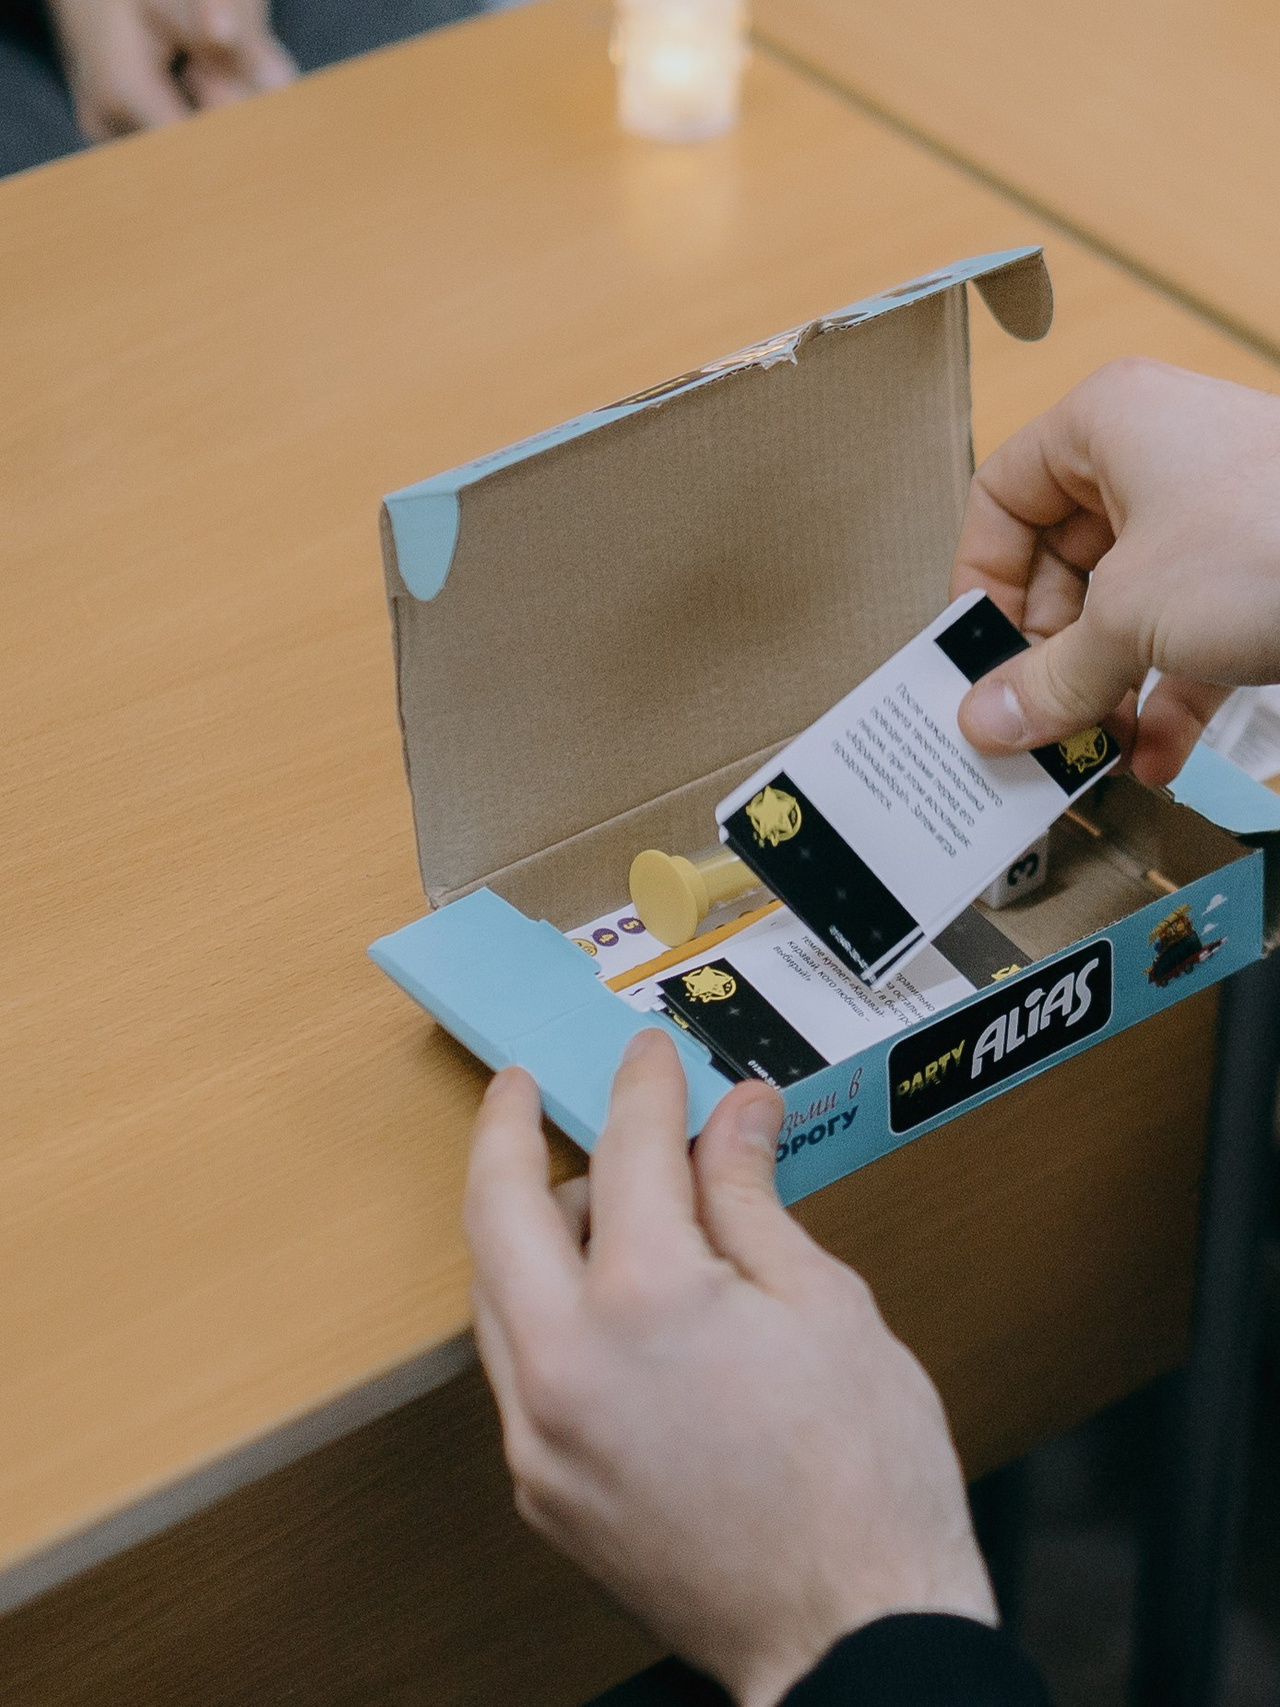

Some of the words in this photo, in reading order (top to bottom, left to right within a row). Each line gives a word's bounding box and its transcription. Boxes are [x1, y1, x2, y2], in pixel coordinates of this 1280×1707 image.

[896, 682, 924, 716] После
[922, 714, 959, 757] каждого
[1007, 852, 1039, 886] 3
[599, 933, 614, 944] 4
[623, 920, 640, 930] 5
[801, 936, 825, 957] темпе
[818, 971, 837, 988] кого
[834, 988, 864, 1017] любишь
[897, 1039, 966, 1097] PARTY
[776, 1105, 859, 1163] ОРОГУ
